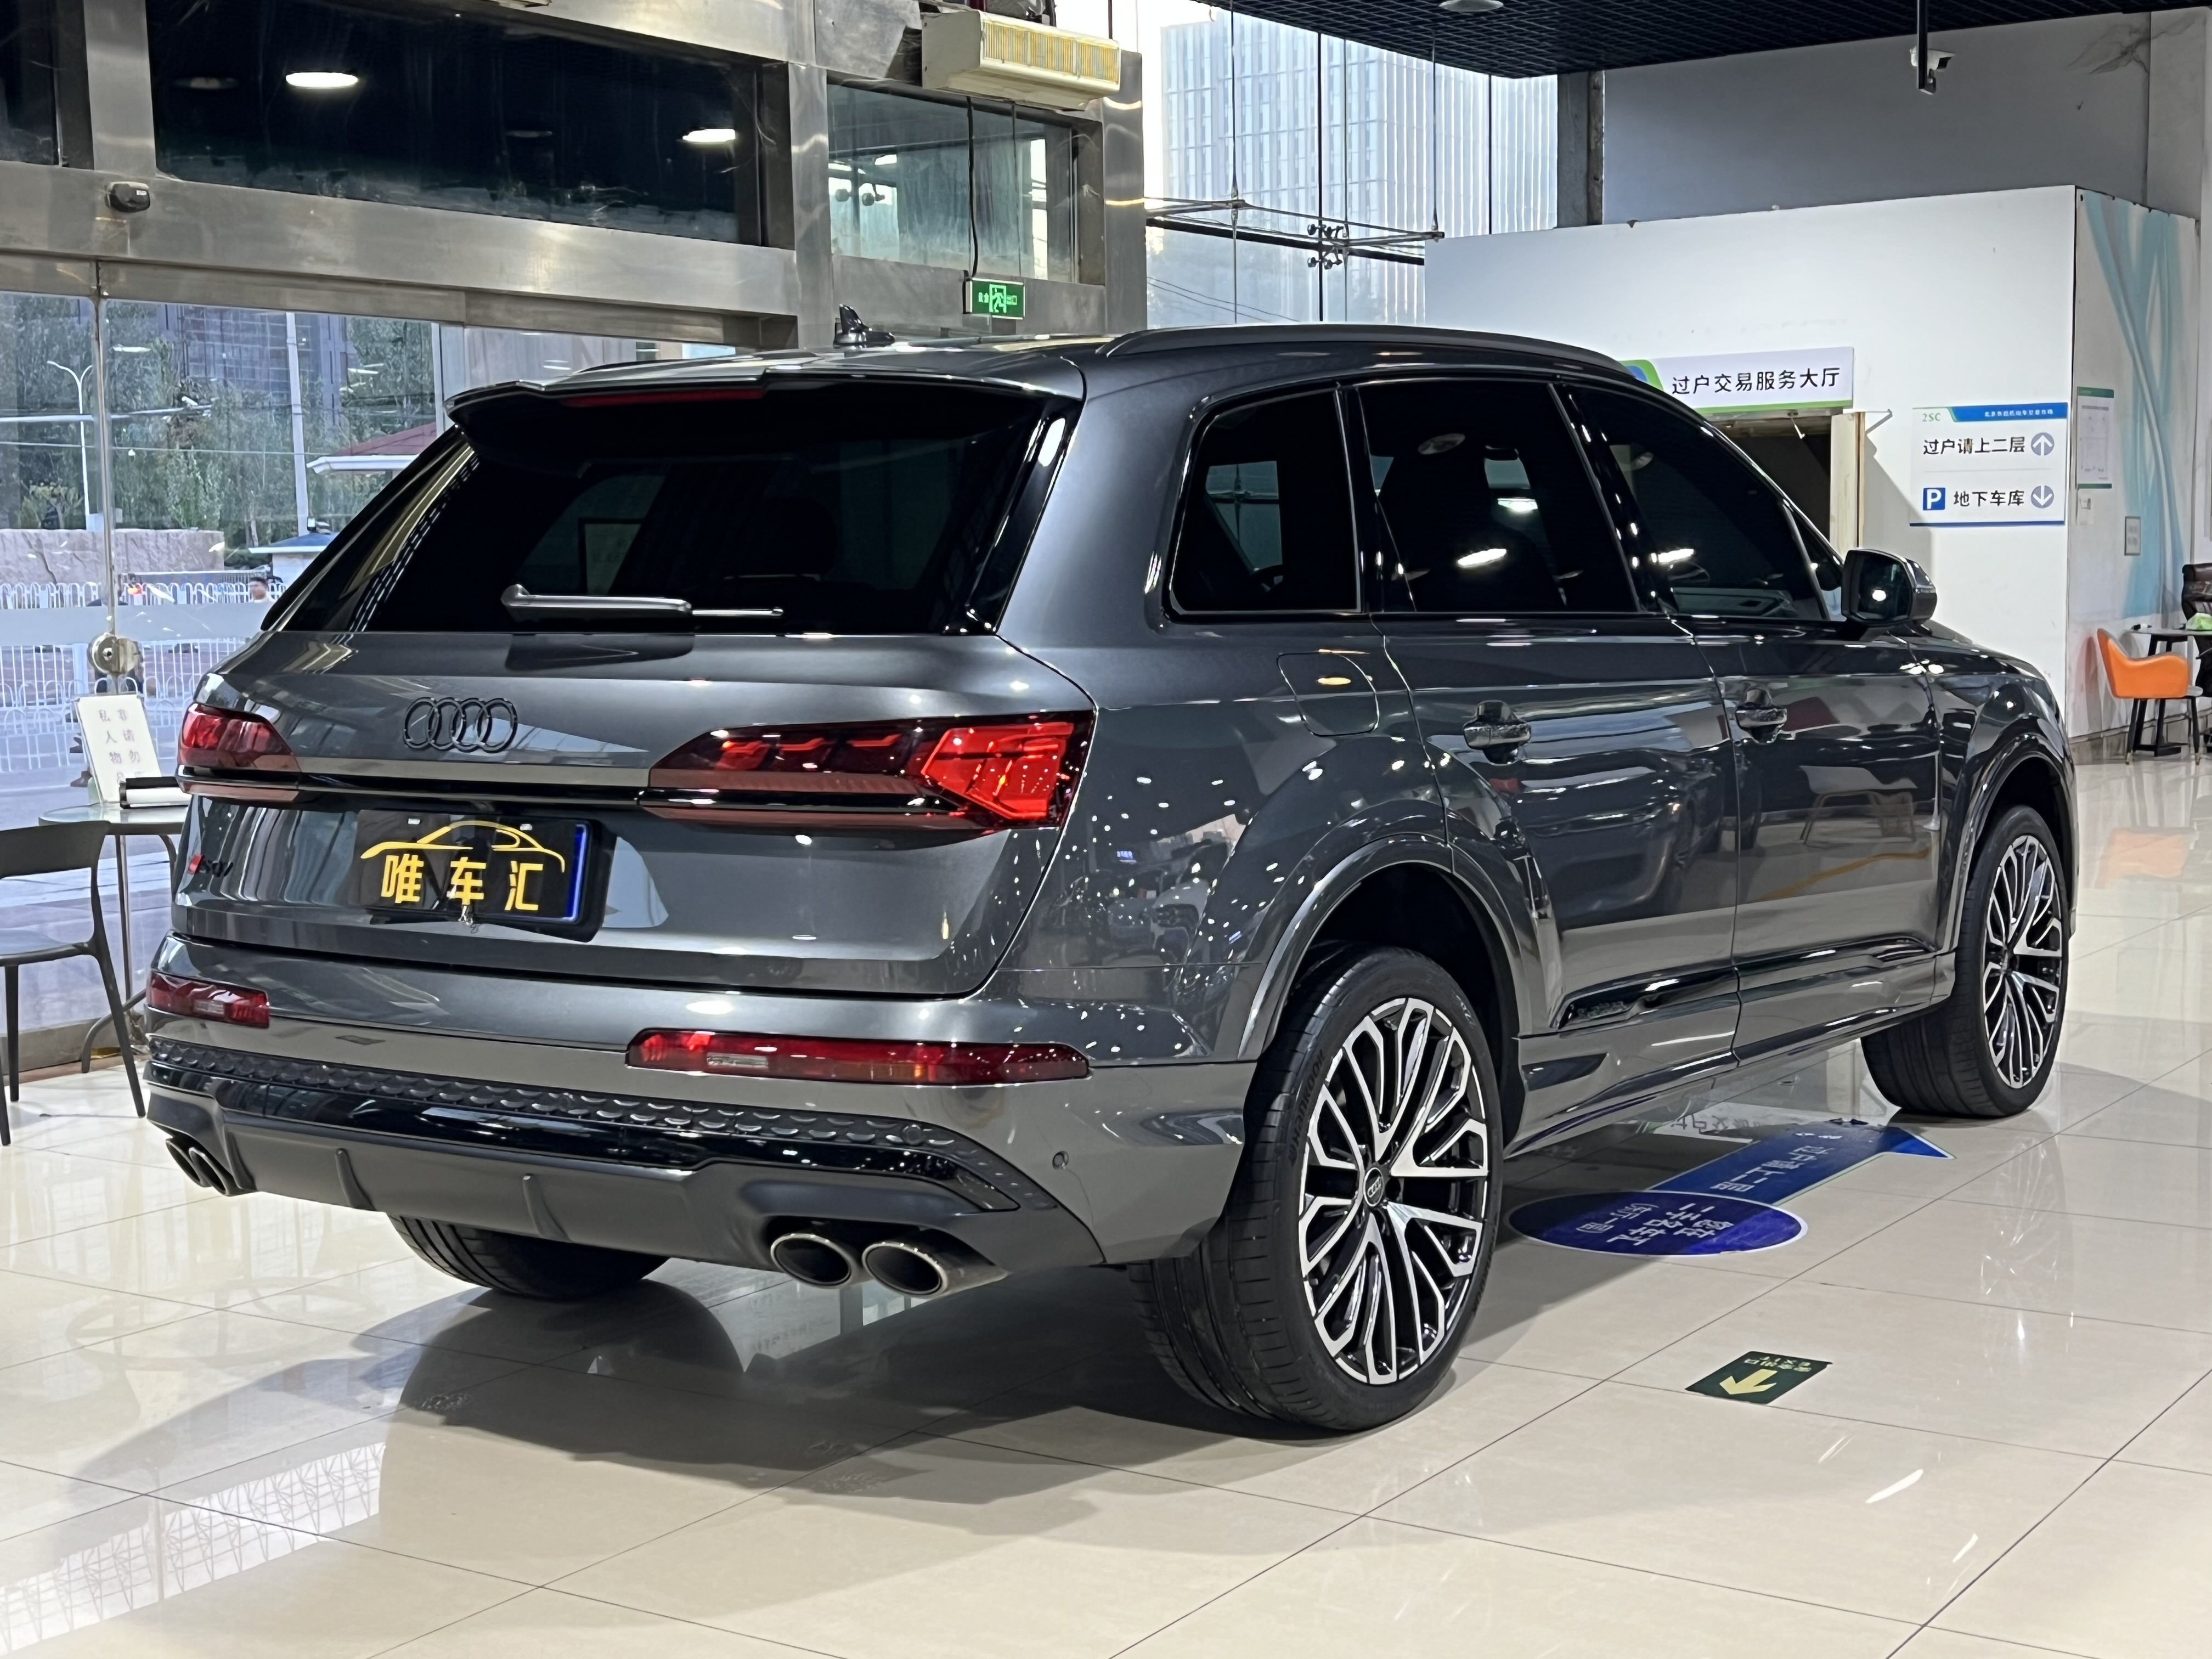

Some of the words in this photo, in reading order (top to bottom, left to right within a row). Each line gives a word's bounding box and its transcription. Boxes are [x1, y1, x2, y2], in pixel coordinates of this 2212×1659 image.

[1672, 367, 1841, 394] 过户交易服务大厅
[1922, 413, 1941, 422] 2SC
[1923, 436, 2025, 455] 过户请上二层
[1927, 489, 1942, 510] P
[1953, 489, 2025, 507] 地下车库
[381, 853, 544, 911] 唯车汇
